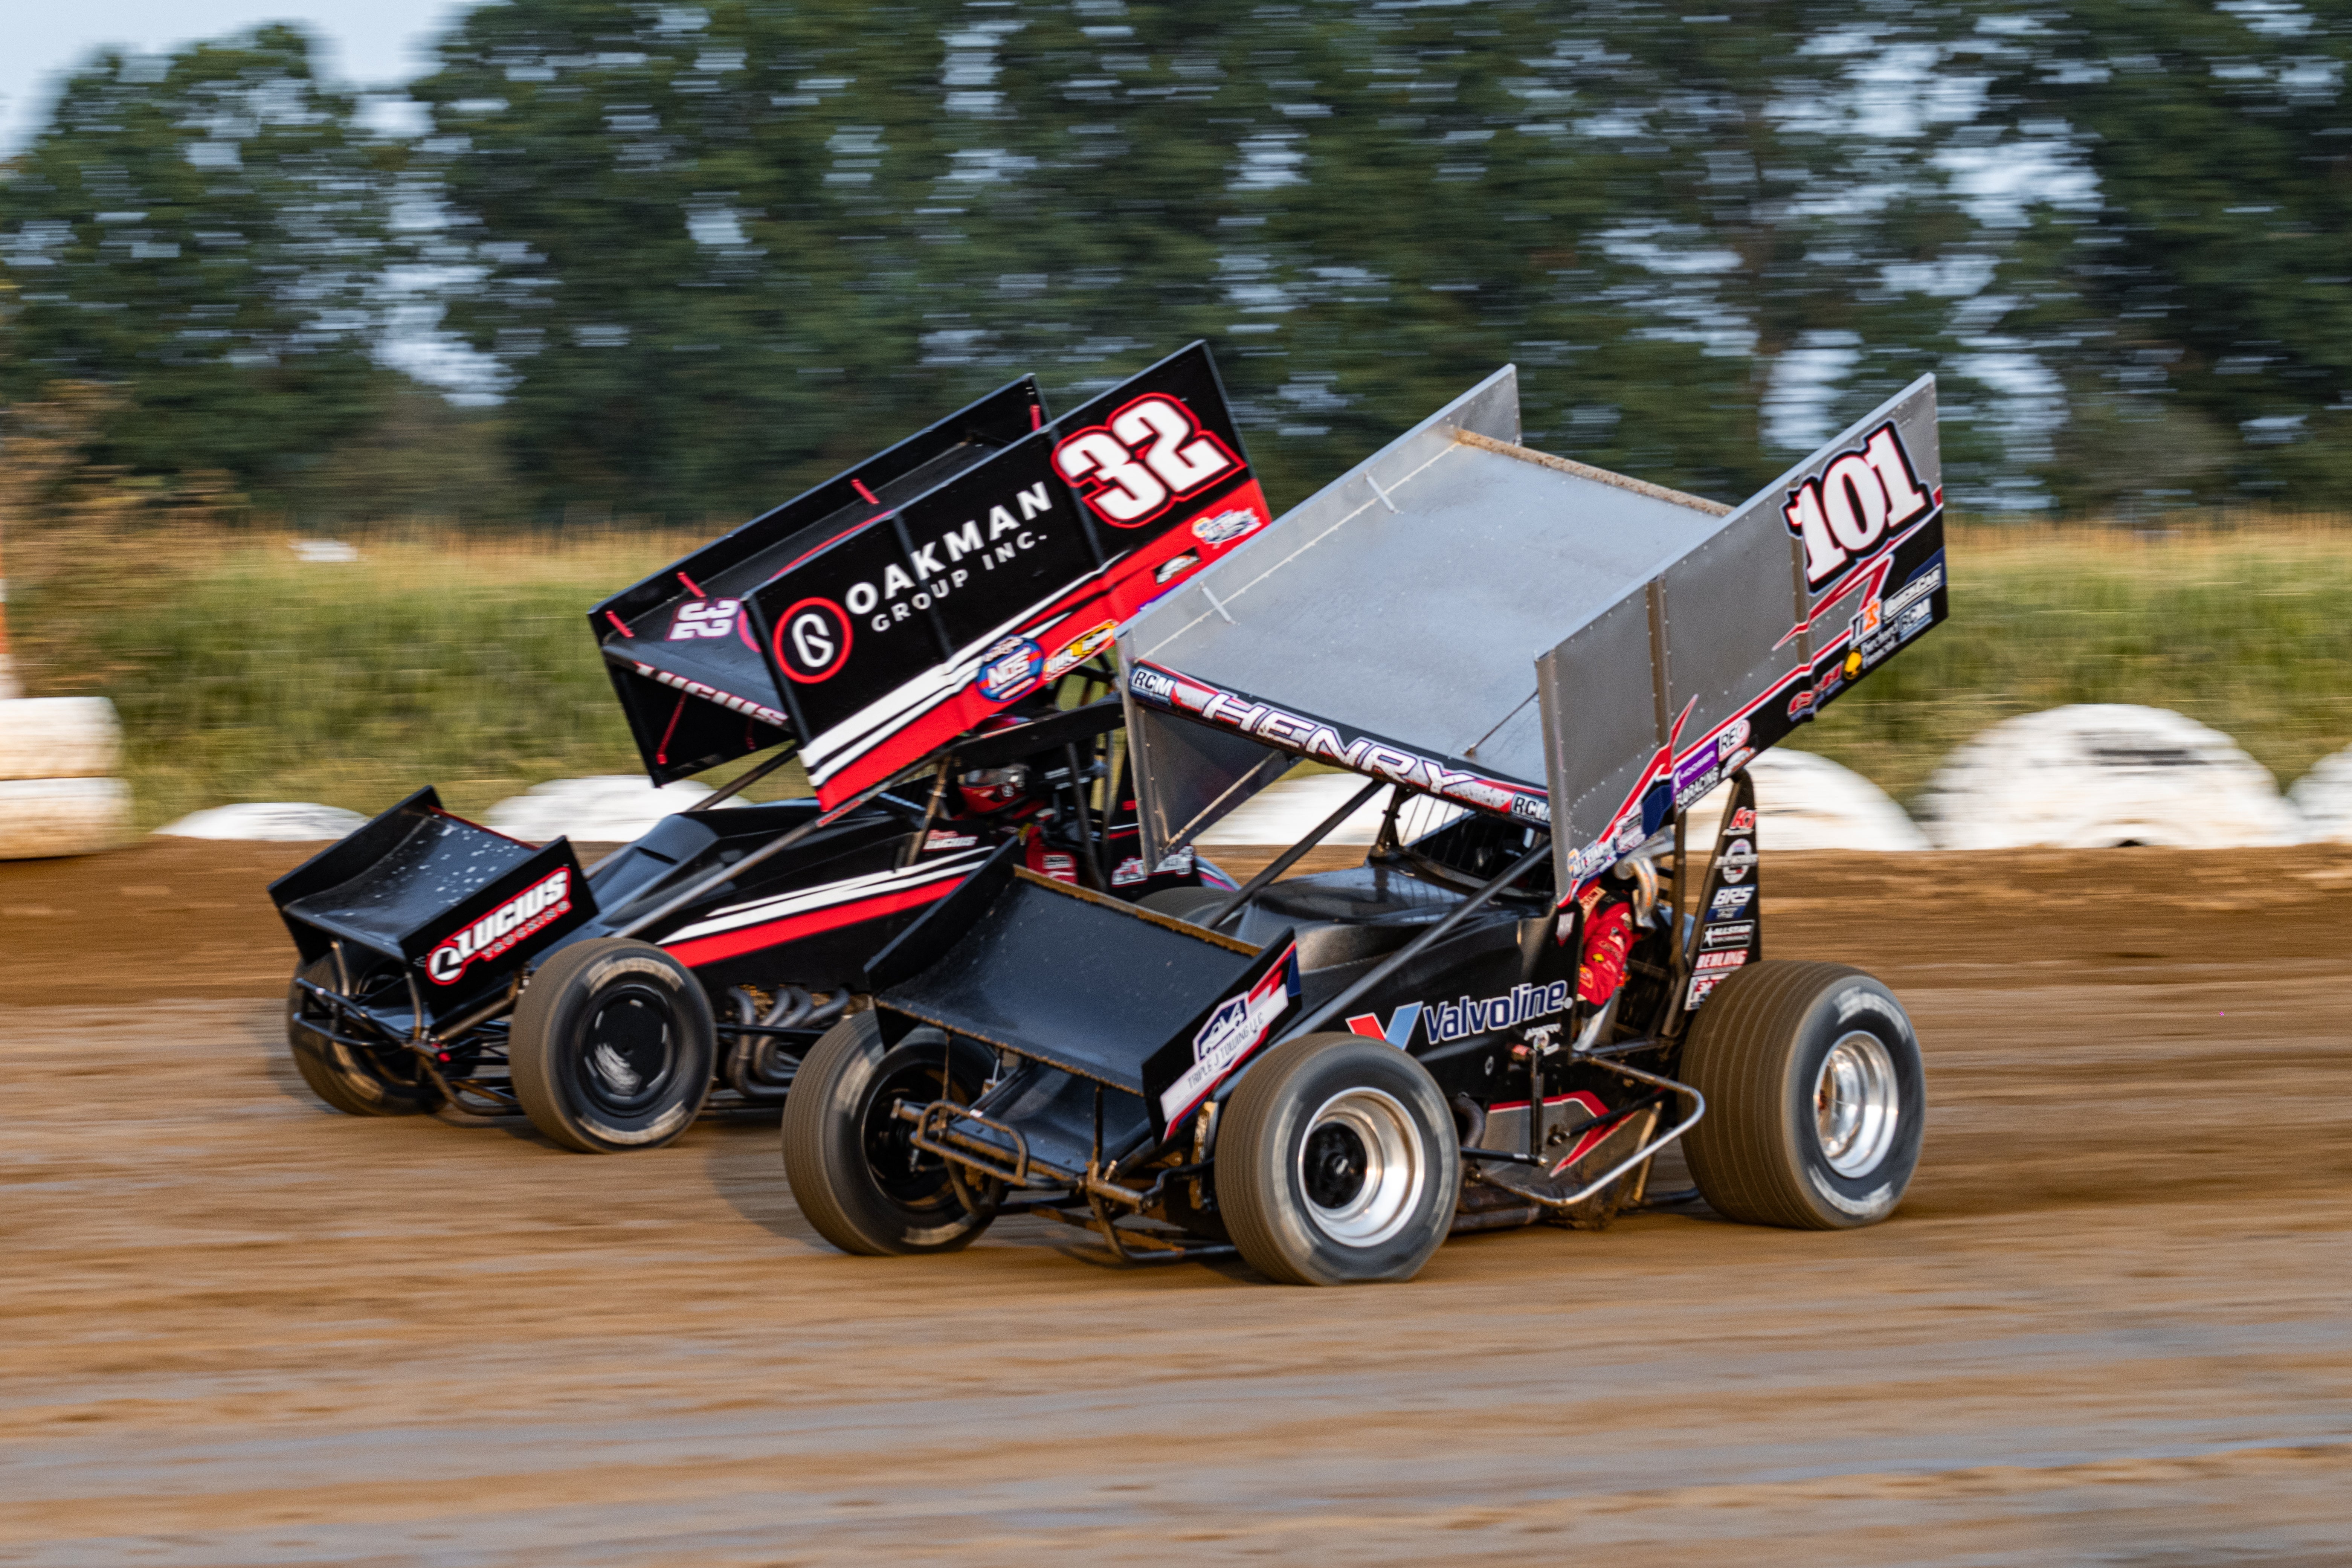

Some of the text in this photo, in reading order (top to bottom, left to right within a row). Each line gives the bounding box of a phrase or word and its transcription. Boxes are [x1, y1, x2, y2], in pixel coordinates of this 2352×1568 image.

[1055, 398, 1235, 523] 32
[1786, 426, 1927, 584] 101
[845, 481, 1053, 615] OAKMAN
[871, 569, 969, 632] GROUP
[1134, 670, 1175, 697] RCM
[1201, 692, 1476, 794] HENRY
[1513, 796, 1551, 823] RCM
[453, 870, 568, 959] LUCIUS
[481, 900, 571, 959] TRUCKING
[1713, 886, 1756, 905] BRS
